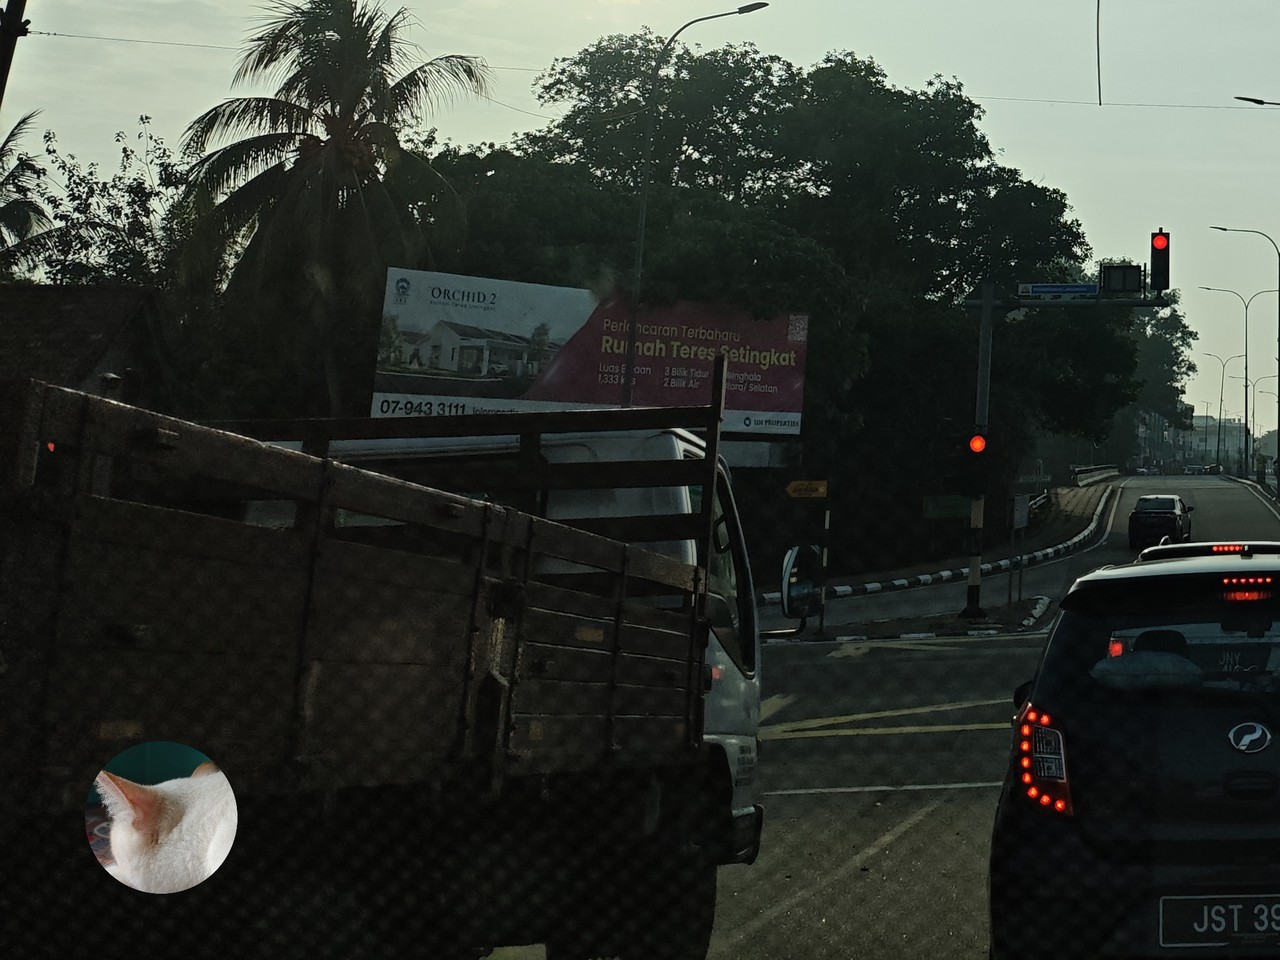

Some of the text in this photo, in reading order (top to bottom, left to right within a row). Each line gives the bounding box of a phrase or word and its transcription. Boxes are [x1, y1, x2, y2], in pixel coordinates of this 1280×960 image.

[431, 286, 497, 305] ORCHID 2
[681, 324, 740, 342] Terbaharu
[670, 341, 715, 361] Teres
[720, 344, 797, 370] Setingkat
[599, 363, 651, 375] Luas Baan
[664, 366, 709, 379] 3 Bilik Tidur
[598, 373, 619, 385] 1,333
[663, 378, 700, 389] 2 Bilik Air
[748, 383, 778, 393] Selatan
[380, 399, 432, 416] 07-943
[436, 402, 466, 416] 3111
[764, 419, 799, 427] PROPERTIES
[1193, 904, 1243, 933] JST
